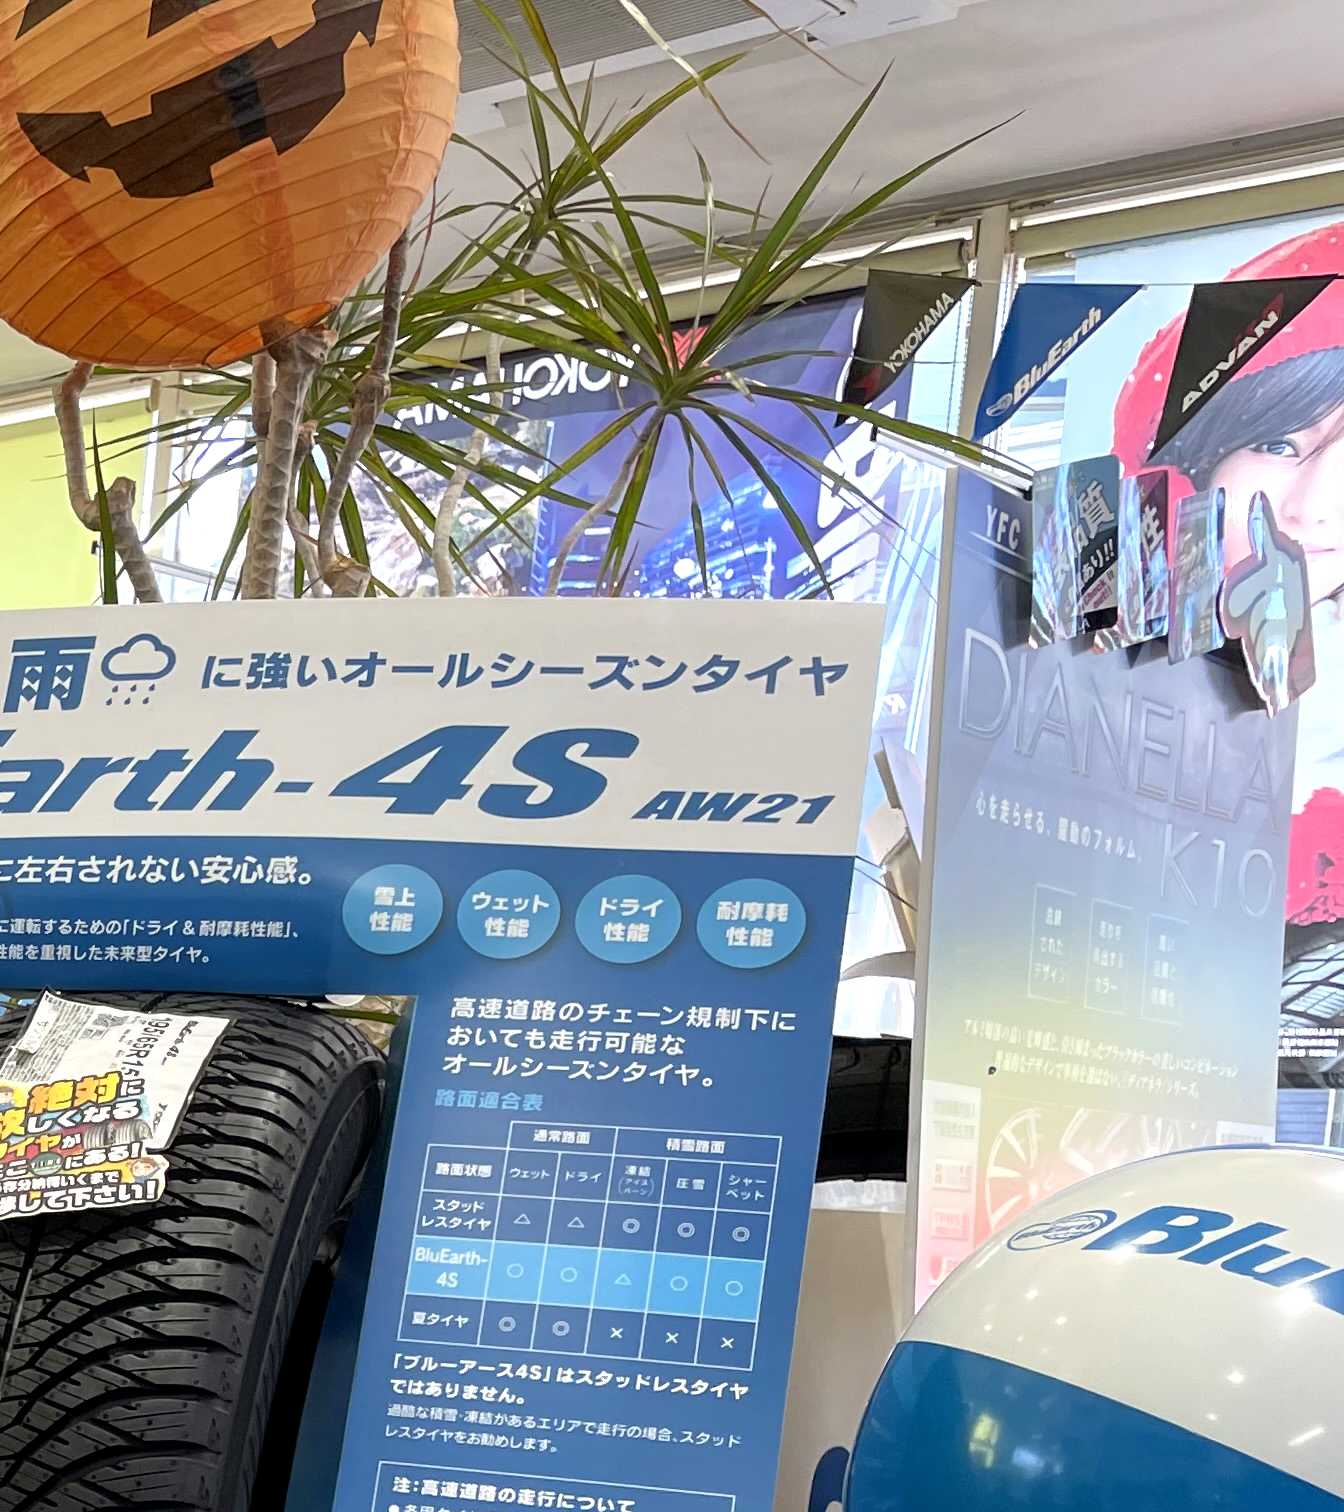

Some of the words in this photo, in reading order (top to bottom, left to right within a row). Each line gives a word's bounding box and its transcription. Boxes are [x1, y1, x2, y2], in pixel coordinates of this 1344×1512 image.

[882, 292, 954, 372] YOKOHAMA
[1014, 307, 1101, 400] BluEarth
[1181, 311, 1278, 413] ADVAN
[986, 505, 1021, 550] YFC
[3, 635, 98, 713] 雨
[958, 628, 1280, 833] DIANELLA
[631, 791, 835, 824] AW21
[1161, 824, 1275, 916] K10
[374, 887, 416, 907] 雪上
[472, 891, 549, 914] ウェット
[600, 896, 664, 916] ドライ
[369, 911, 413, 933] 性能
[717, 902, 790, 923] 耐摩耗
[484, 917, 530, 939] 性能
[603, 922, 650, 944] 性能
[726, 927, 774, 948] 性能
[447, 1027, 686, 1056] おいても走行可能な
[442, 1054, 713, 1088] オールシーズンタイヤ。
[435, 1090, 543, 1111] 路面適合表
[534, 1129, 590, 1145] 通常路面
[667, 1138, 725, 1154] 積雪路面
[436, 1163, 492, 1178] 路面状態
[510, 1168, 550, 1179] ウェット
[564, 1170, 601, 1183] ドライ
[433, 1199, 484, 1211] スタッド
[422, 1215, 491, 1230] レスタイヤ
[415, 1247, 488, 1266] BluEarth-
[436, 1272, 458, 1288] 4S
[412, 1312, 469, 1327] 夏タイヤ
[390, 1379, 526, 1404] ではありません。
